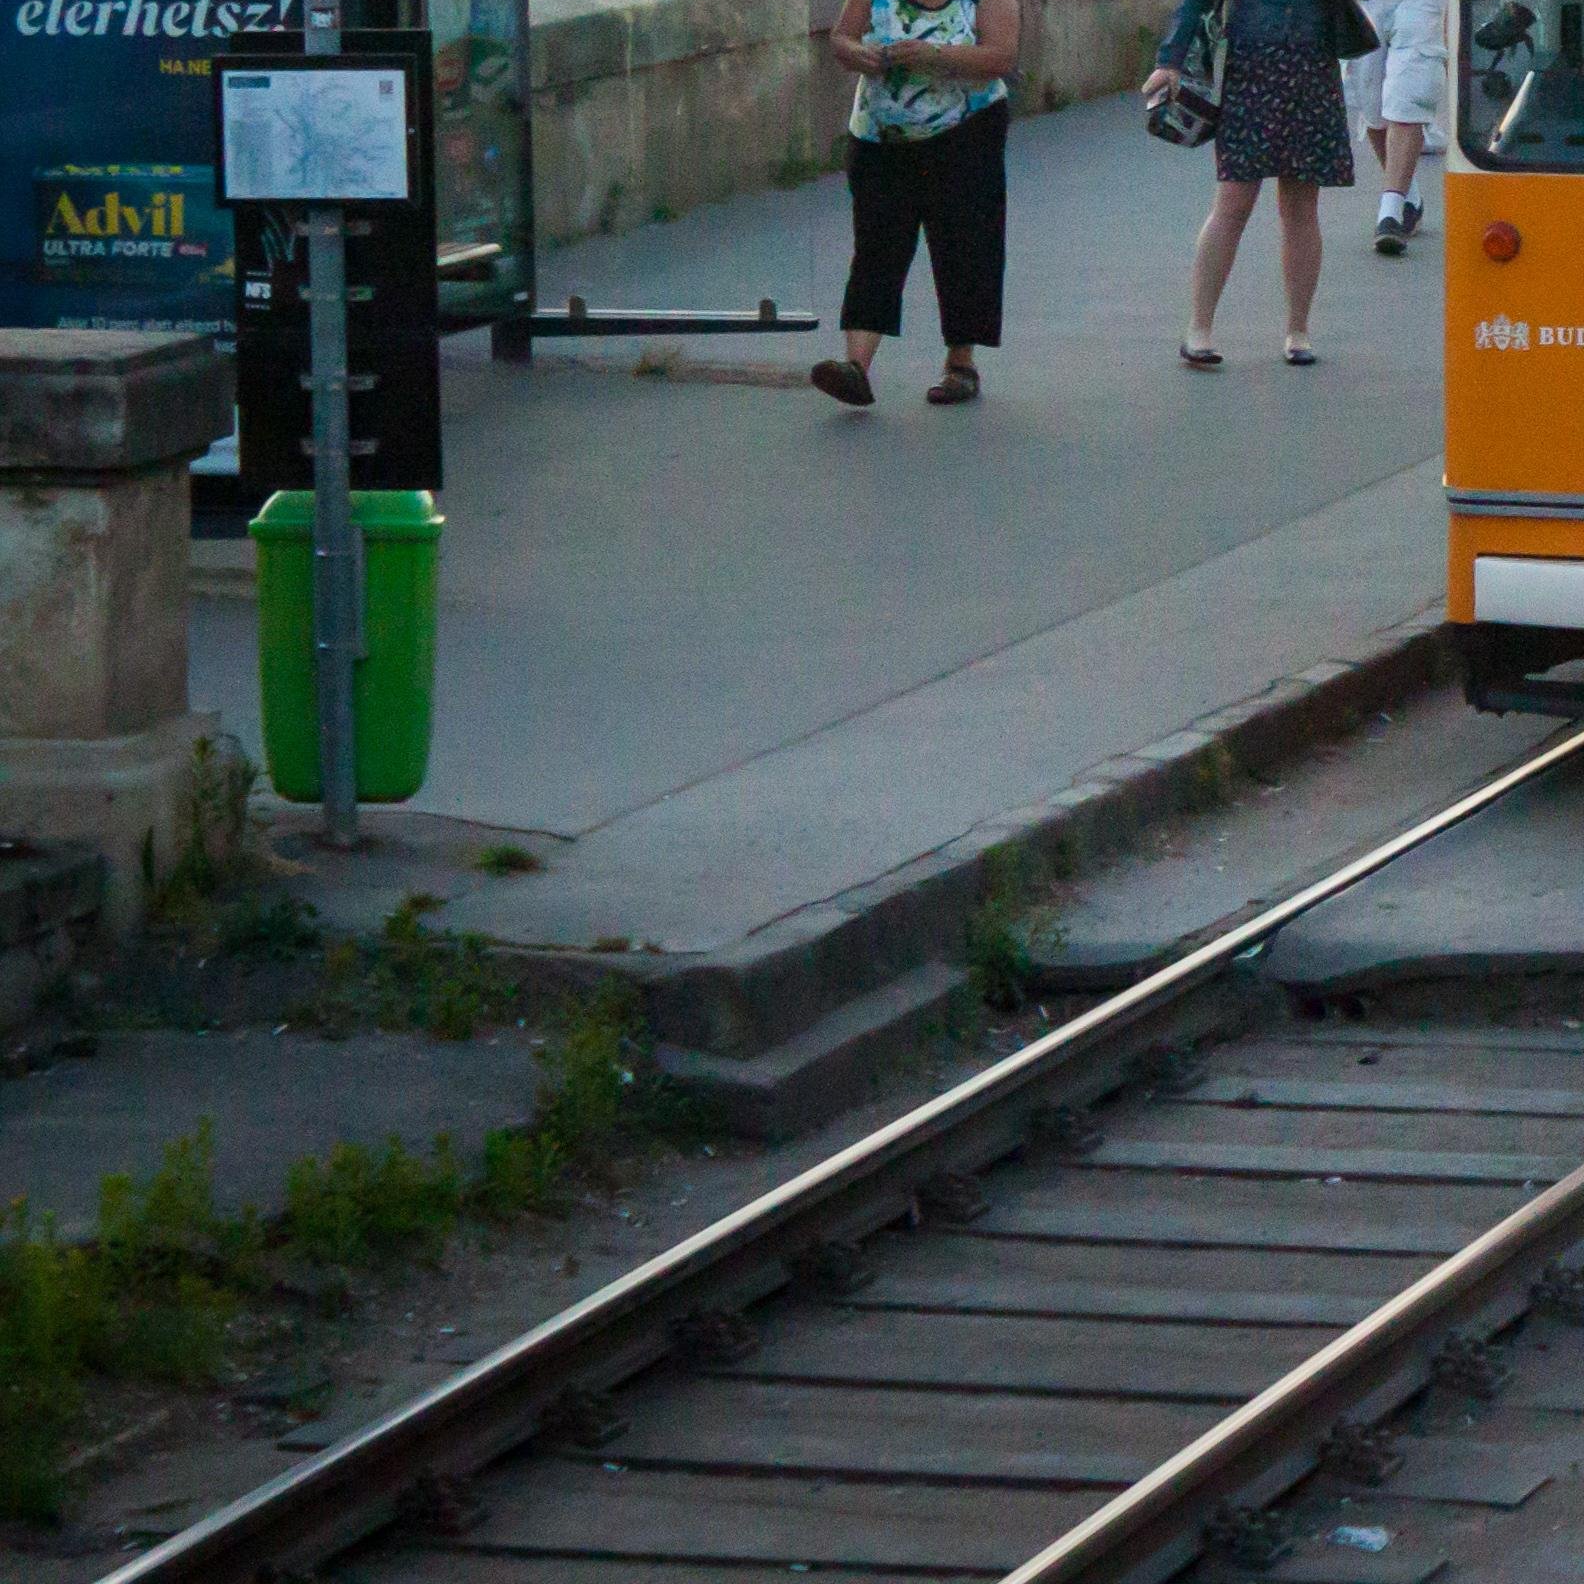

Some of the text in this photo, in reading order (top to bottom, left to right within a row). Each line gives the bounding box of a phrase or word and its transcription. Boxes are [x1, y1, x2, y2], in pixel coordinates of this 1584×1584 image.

[159, 59, 184, 75] HA
[46, 192, 184, 237] Advil
[43, 239, 106, 257] ULTRA
[112, 240, 175, 258] FORTE
